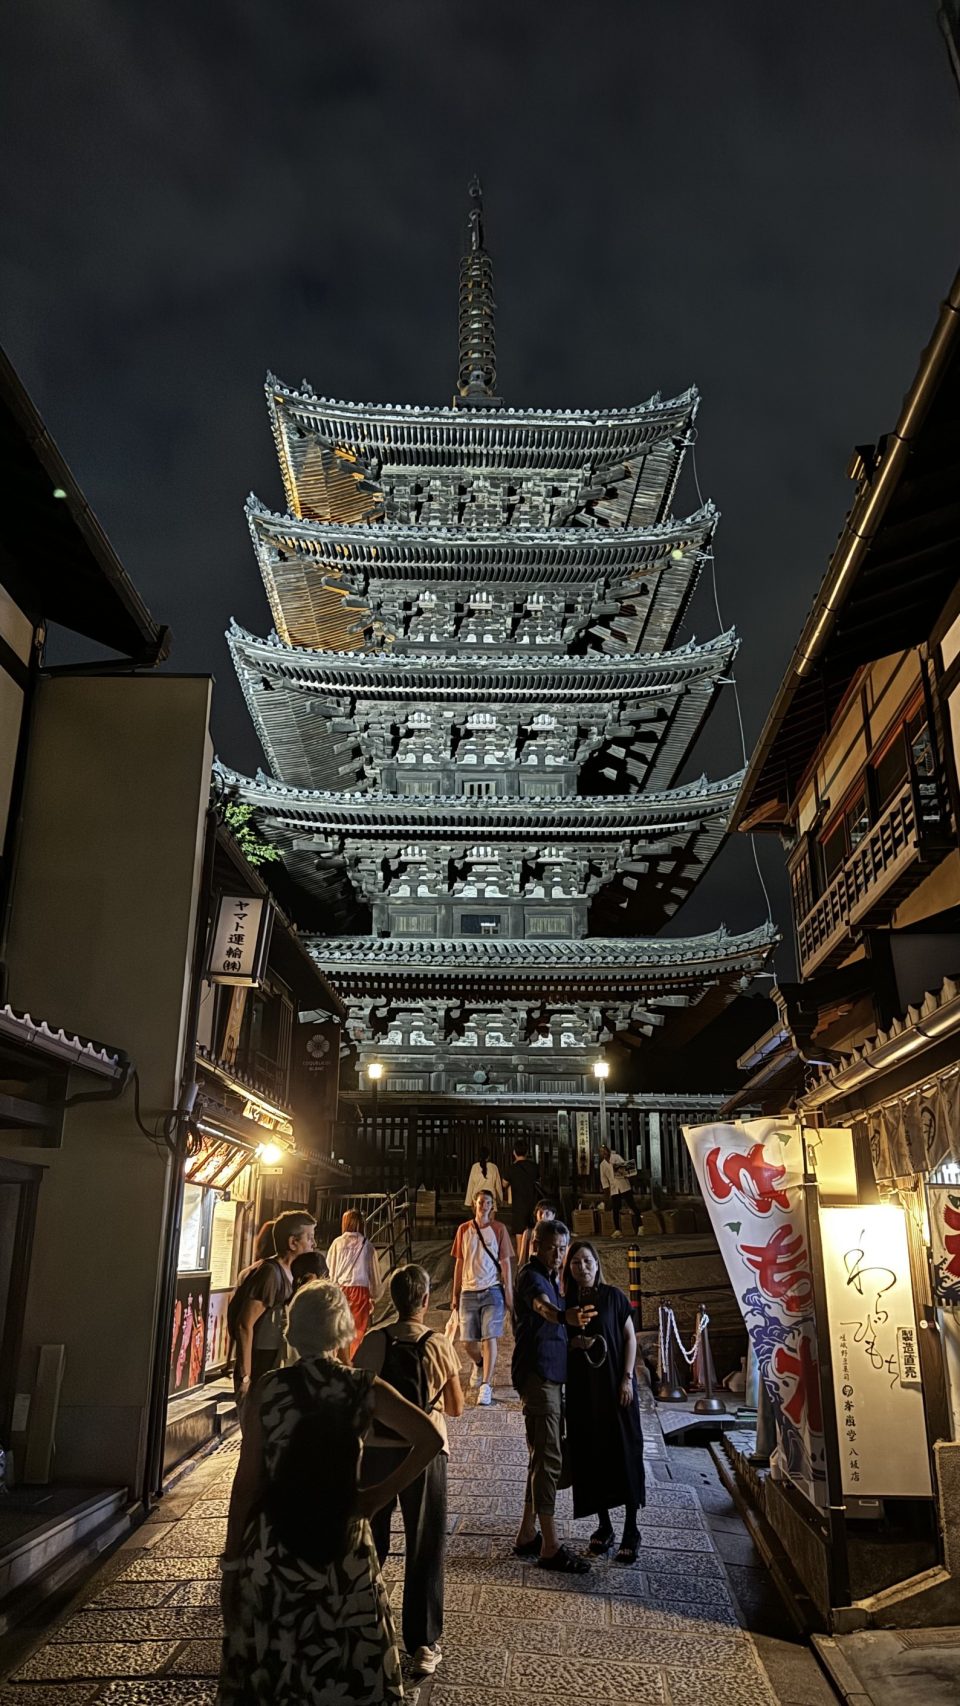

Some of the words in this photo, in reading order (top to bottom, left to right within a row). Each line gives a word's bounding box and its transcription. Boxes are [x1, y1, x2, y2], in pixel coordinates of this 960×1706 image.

[222, 901, 250, 972] ヤマト運輸(株)
[840, 1229, 899, 1389] わらびもち
[901, 1329, 917, 1379] 製造直売
[848, 1447, 860, 1482] 八坂店
